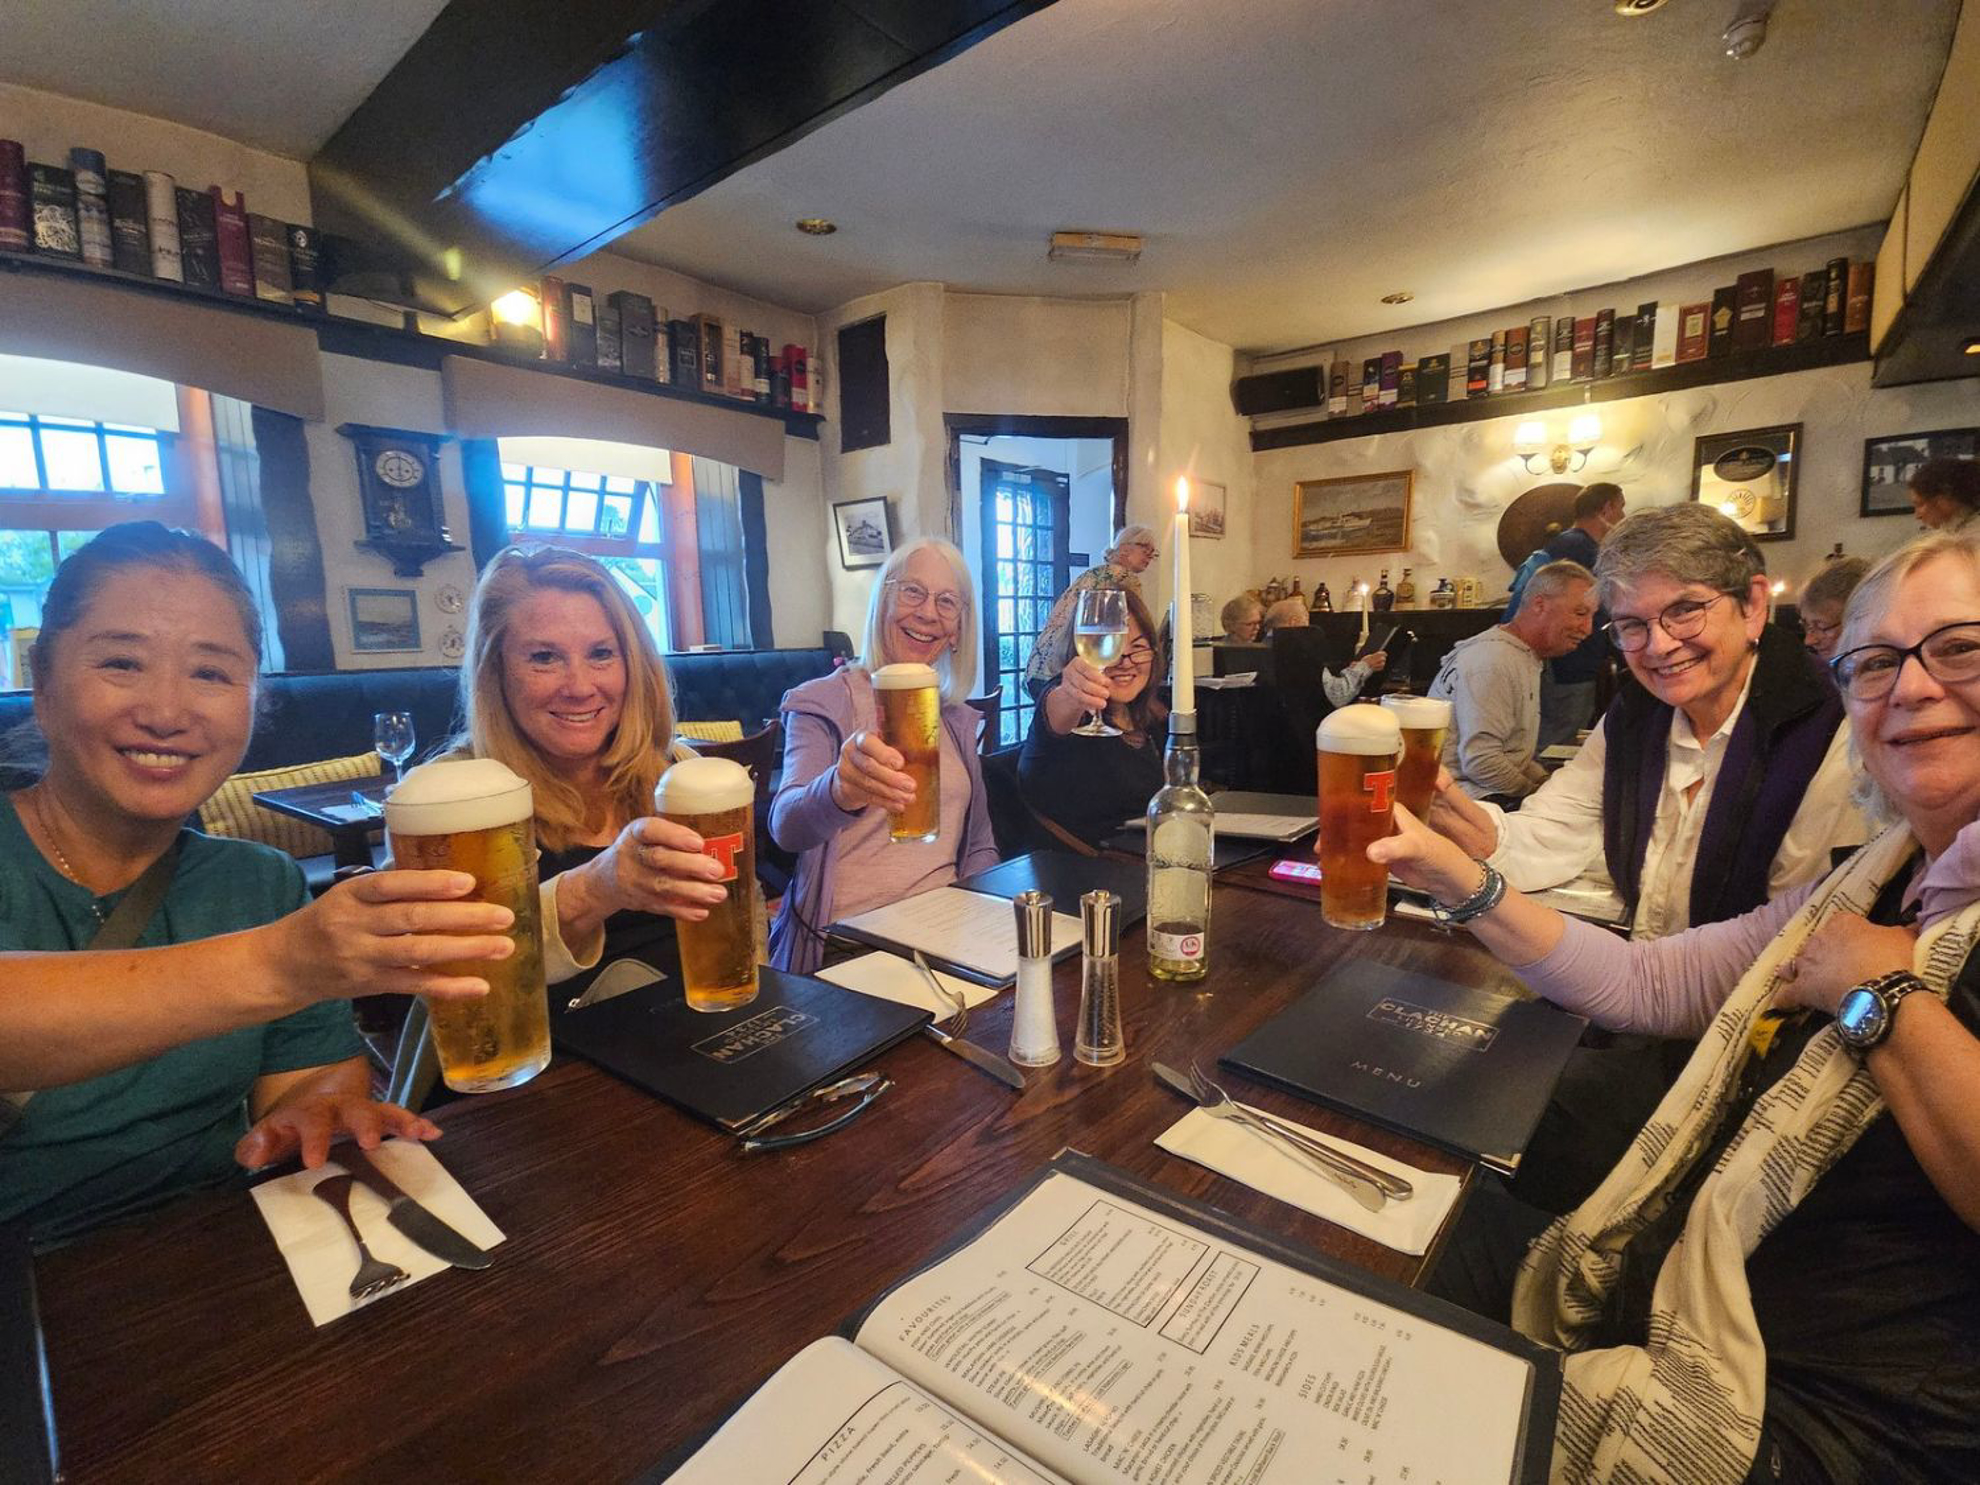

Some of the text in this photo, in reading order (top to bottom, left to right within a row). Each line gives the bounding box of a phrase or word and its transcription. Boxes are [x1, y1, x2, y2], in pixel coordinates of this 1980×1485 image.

[711, 1014, 806, 1059] CLACHAN
[1380, 1002, 1492, 1040] CLACHAN
[1351, 1060, 1421, 1088] MENU
[898, 1293, 951, 1341] FAVOURITES
[1298, 1372, 1316, 1399] SIDES
[820, 1425, 855, 1460] PIZZA
